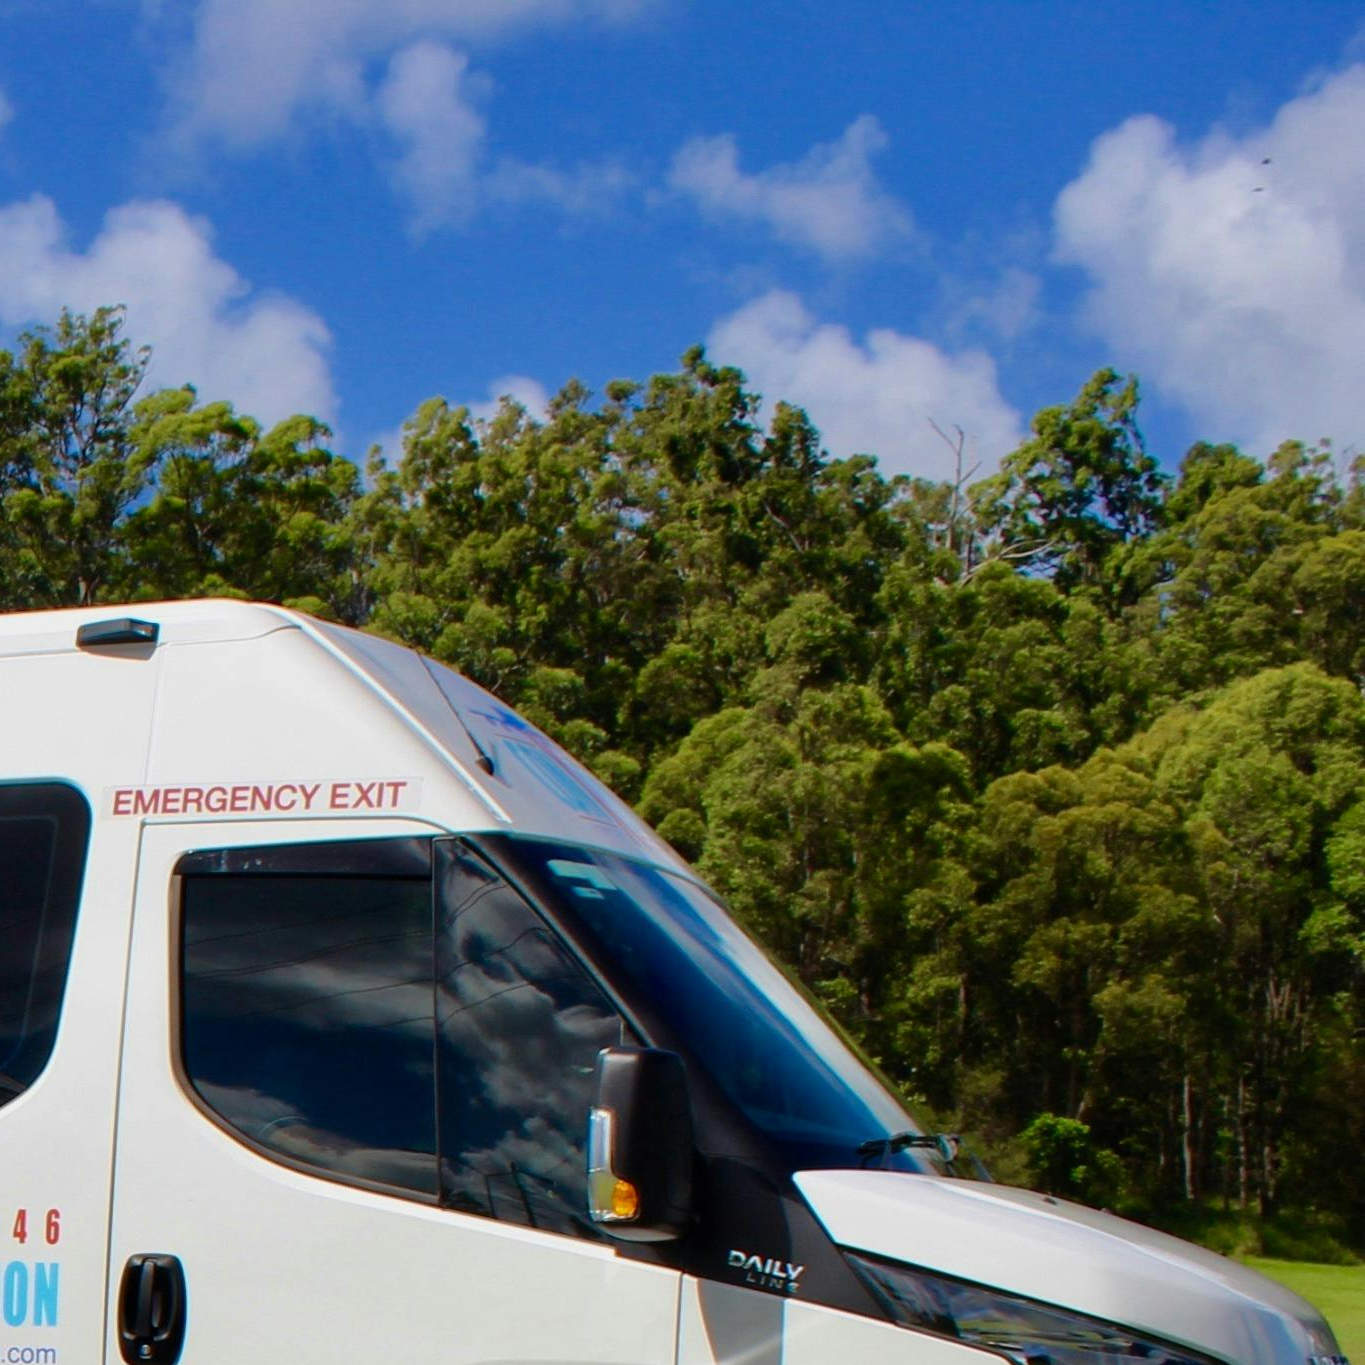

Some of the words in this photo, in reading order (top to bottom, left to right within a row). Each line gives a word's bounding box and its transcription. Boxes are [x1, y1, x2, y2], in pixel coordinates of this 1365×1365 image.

[112, 783, 321, 816] EMERGENCY
[329, 781, 407, 809] EXIT
[728, 1250, 804, 1280] DAILY
[746, 1272, 800, 1293] LINE
